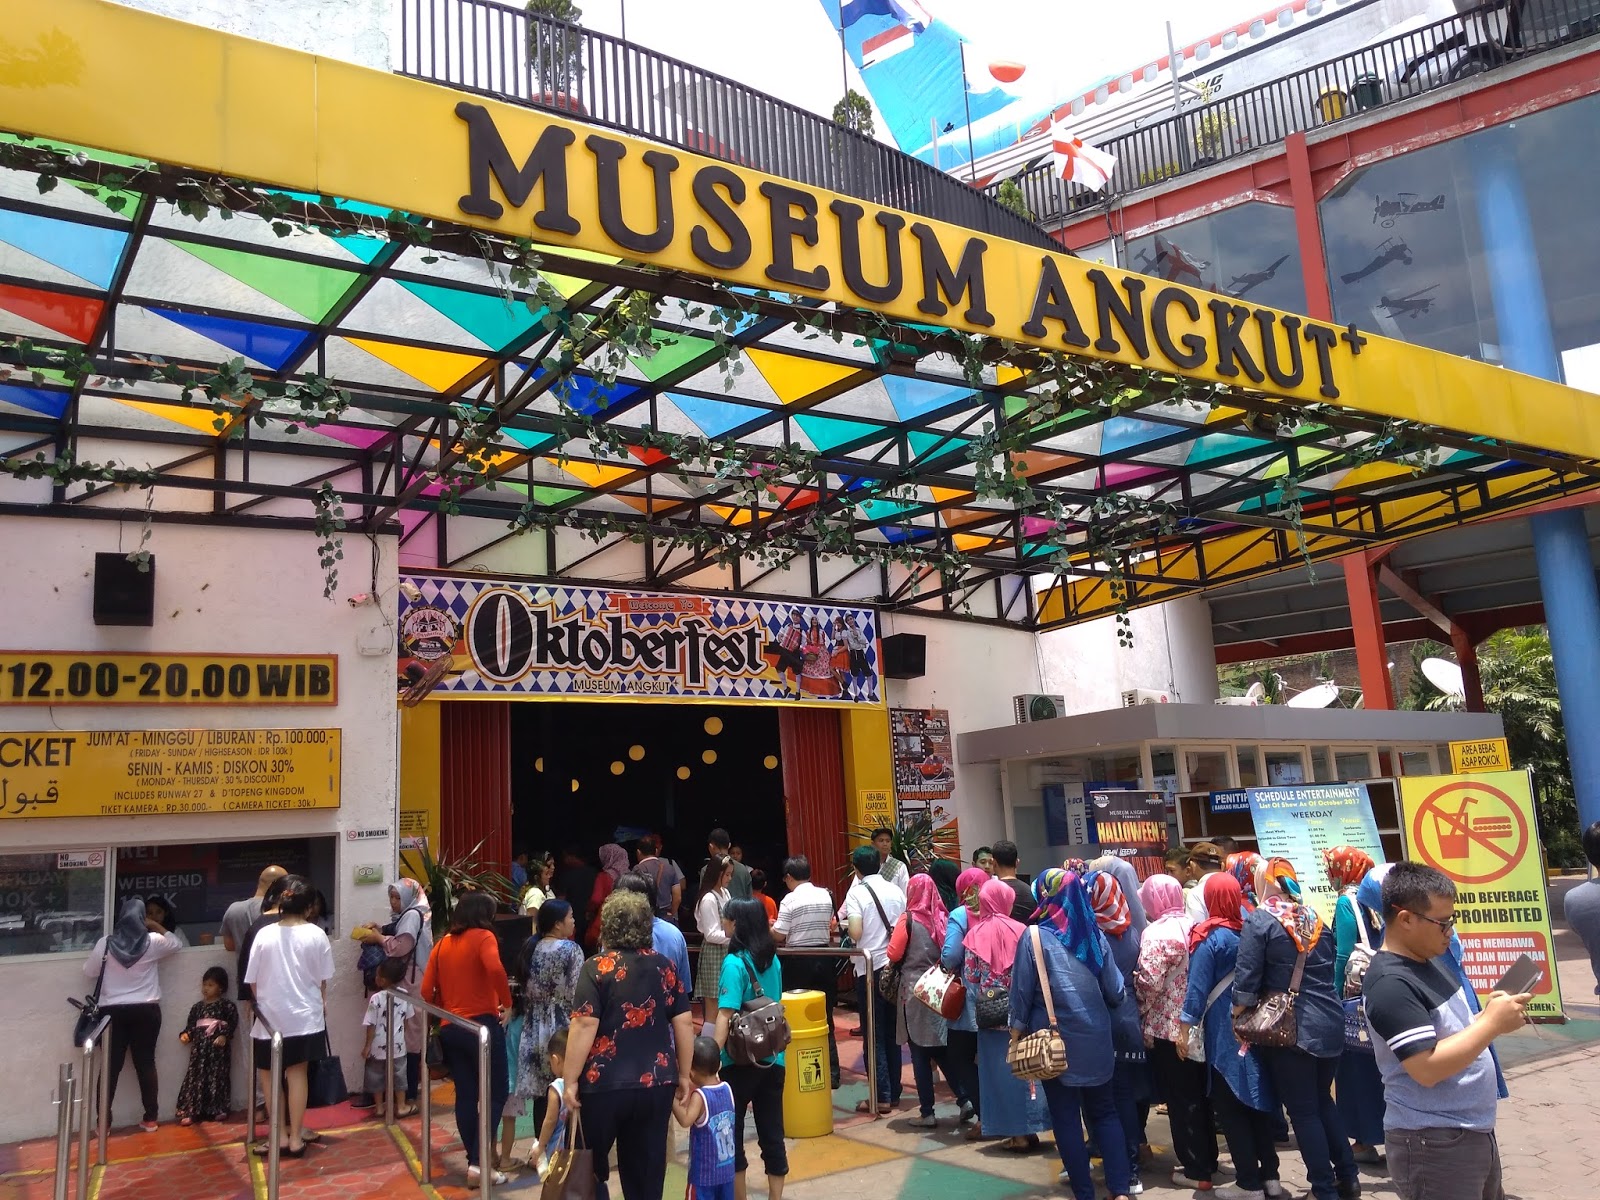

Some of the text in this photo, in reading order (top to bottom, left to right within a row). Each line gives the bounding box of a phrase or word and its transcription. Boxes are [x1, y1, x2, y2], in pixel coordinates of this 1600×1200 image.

[455, 101, 996, 327] MUSEUM
[628, 599, 694, 611] Welcome To
[473, 593, 762, 684] Oktoberfest
[8, 661, 331, 698] 12.00-20.00 WIB
[573, 678, 621, 691] MUSEUM
[87, 731, 130, 747] JUM'AT
[142, 731, 195, 746] MINGGU
[208, 731, 256, 745] LIBURAN
[0, 737, 76, 768] CKET
[167, 748, 197, 757] SUNDAY
[204, 747, 253, 756] HIGHSEASON
[258, 747, 270, 756] IDR
[1461, 742, 1497, 756] AREA BEBAS
[127, 761, 163, 776] SENIN
[175, 760, 213, 775] KAMIS
[223, 760, 268, 774] DISKON
[271, 759, 295, 773] 30%
[1461, 754, 1501, 767] ASAP ROKOK
[183, 776, 220, 785] THURSDAY
[114, 787, 305, 801] INCLUDES RUNWAY 27 & D'TOPENG KINGDOM
[1255, 788, 1360, 803] SCHEDULE ENTERTAINMENT
[101, 805, 122, 814] TIKET
[124, 804, 159, 814] KAMERA
[266, 800, 291, 809] TICKET
[1317, 799, 1344, 807] October
[1291, 810, 1334, 819] WEEKDAY
[366, 829, 388, 837] SMOKING
[1096, 821, 1160, 843] HALLOWEEN
[1119, 847, 1138, 857] LEGEND
[59, 853, 88, 868] NO SMOKING
[118, 873, 203, 890] WEEKEND
[1453, 890, 1540, 905] AND BEVERAGE
[1454, 907, 1543, 924] PROHIBITED
[1460, 937, 1535, 949] ANG MEMBAWA
[1476, 951, 1496, 962] DAN
[1465, 965, 1498, 975] DALAM
